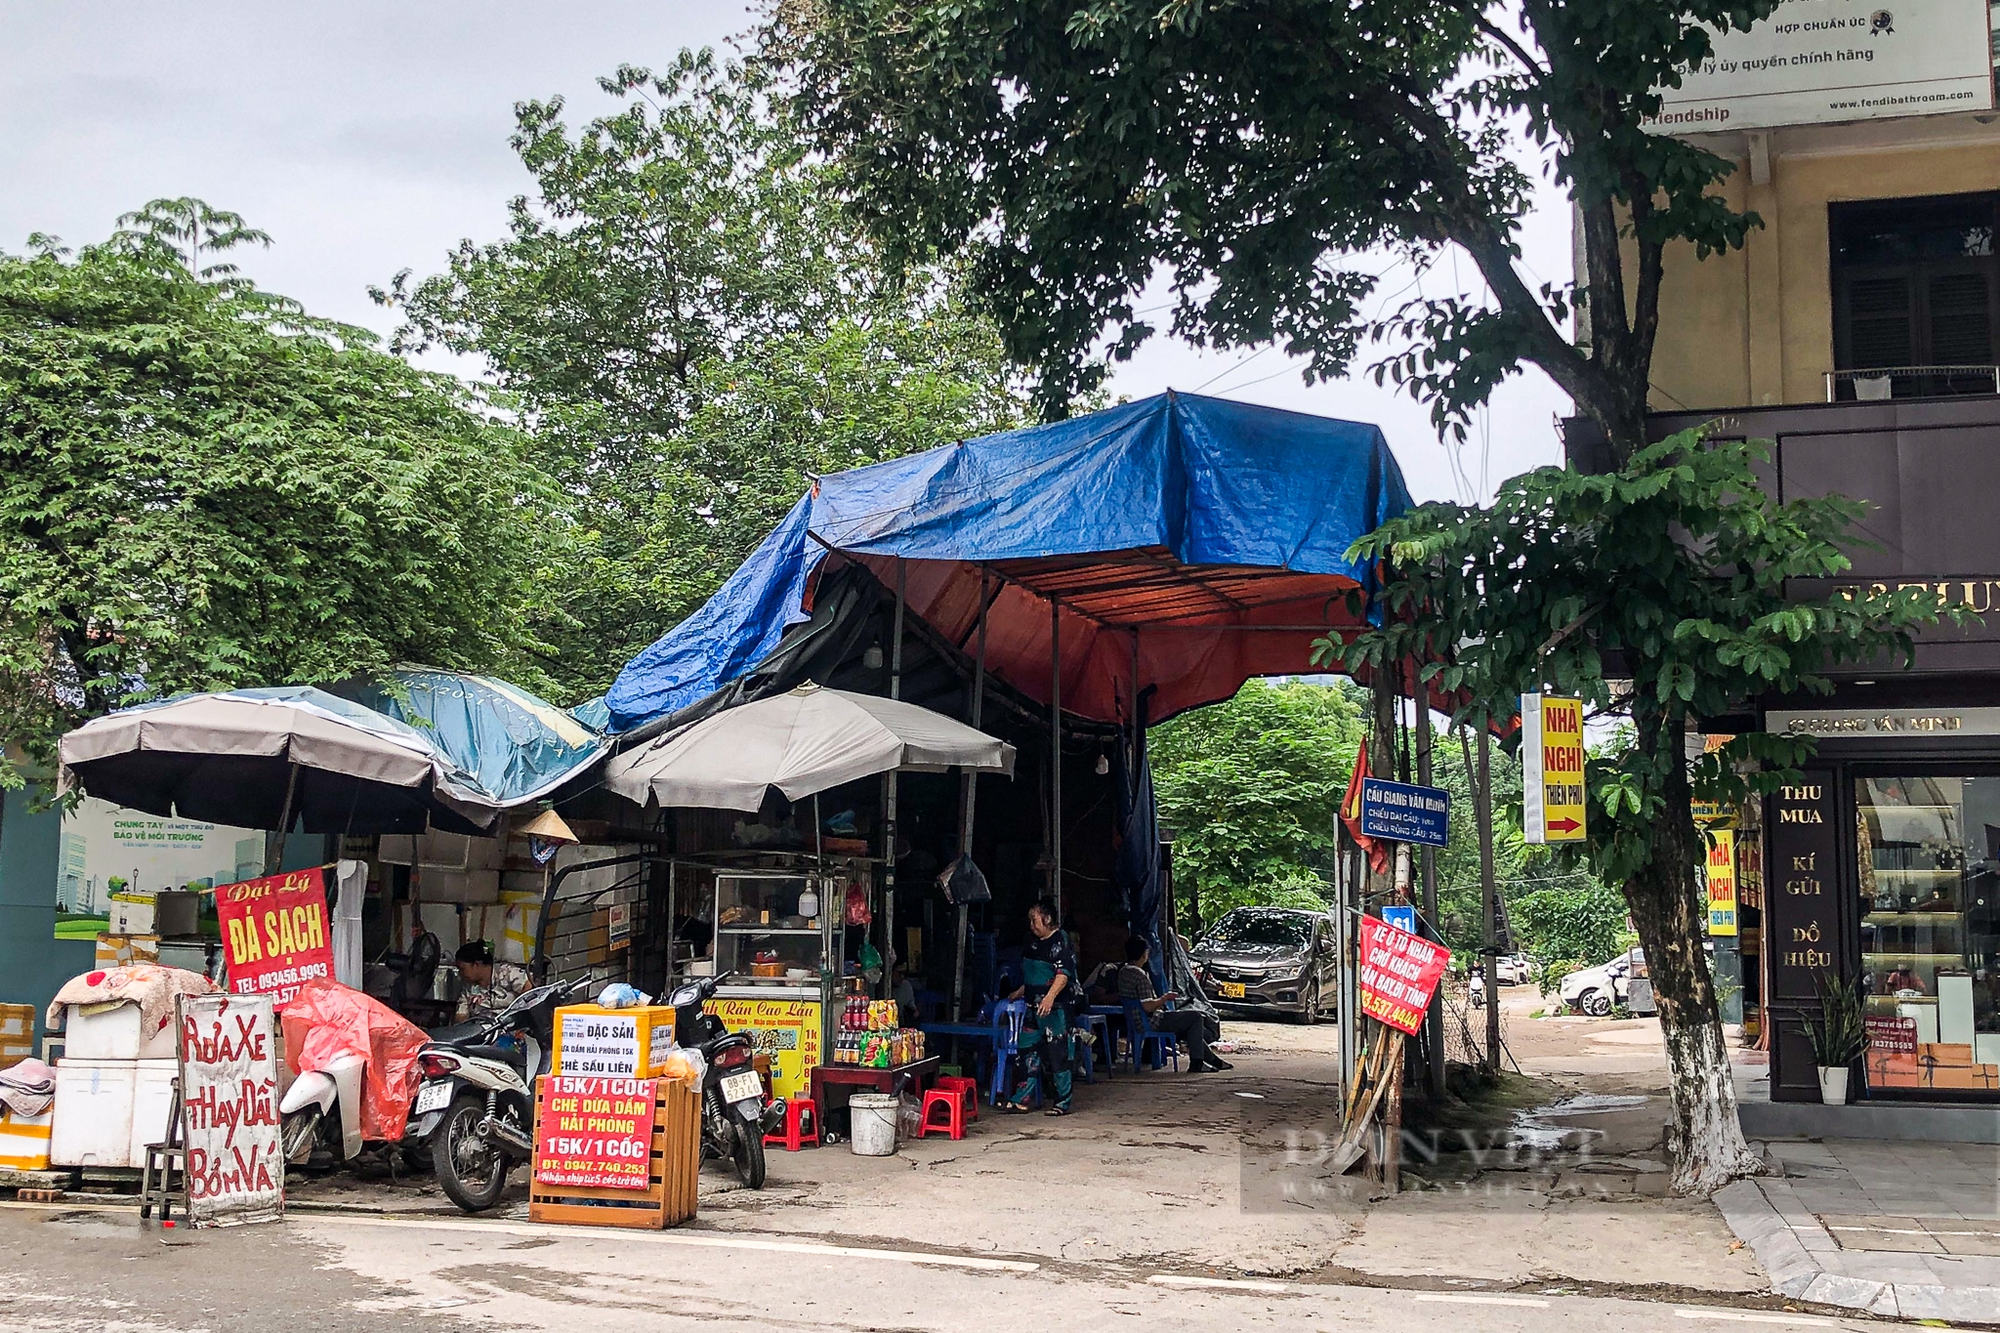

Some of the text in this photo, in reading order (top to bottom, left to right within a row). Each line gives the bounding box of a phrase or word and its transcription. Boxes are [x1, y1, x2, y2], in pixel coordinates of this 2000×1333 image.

[1775, 25, 1800, 35] HỢP
[1849, 17, 1866, 28] ÚC
[1704, 60, 1716, 74] lý
[1721, 58, 1738, 73] ủy
[1742, 54, 1787, 72] quyền
[1791, 50, 1833, 65] chính
[1933, 581, 2000, 614] LU
[1545, 703, 1578, 733] NHÀ
[1909, 716, 1962, 731] MINH
[1544, 738, 1582, 772] NGHỈ
[1384, 791, 1408, 807] GIANG
[1409, 792, 1425, 810] VĂN
[1780, 785, 1823, 800] THU
[114, 820, 144, 829] CHUNG
[147, 821, 164, 829] TAY
[1779, 808, 1823, 824] MUA
[1792, 852, 1816, 871] KÍ
[227, 873, 311, 902] Đại Lý
[1709, 868, 1733, 901] NGHỈ
[1785, 876, 1822, 895] GỬI
[227, 902, 325, 966] ĐÁ SẠCH
[1792, 920, 1821, 943] ĐỒ
[1371, 923, 1388, 944] XE
[1394, 933, 1409, 951] TÔ
[1405, 942, 1436, 965] NHẬN
[1369, 946, 1423, 982] CHỞ KHÁCH
[1783, 948, 1832, 970] HIỆU
[236, 976, 258, 994] TEL:
[1404, 983, 1429, 1010] TỈNH
[723, 1001, 752, 1016] Rán
[756, 1001, 782, 1017] Cao
[233, 1013, 267, 1063] XE
[587, 1022, 609, 1041] ĐẶC
[612, 1021, 634, 1039] SẢN
[805, 1029, 818, 1040] 1k
[558, 1044, 570, 1053] ỪA
[622, 1047, 634, 1056] 15K
[804, 1041, 817, 1052] 3k
[558, 1059, 579, 1071] CHÈ
[608, 1060, 633, 1074] LIÊN
[804, 1054, 817, 1065] 6k
[727, 1074, 753, 1089] 88-F1
[551, 1096, 579, 1113] CHÈ
[582, 1097, 611, 1114] DỪA
[560, 1113, 636, 1135] HẢI PHÒNG
[564, 1160, 646, 1175] 0947.740.253
[541, 1171, 566, 1184] Nhận
